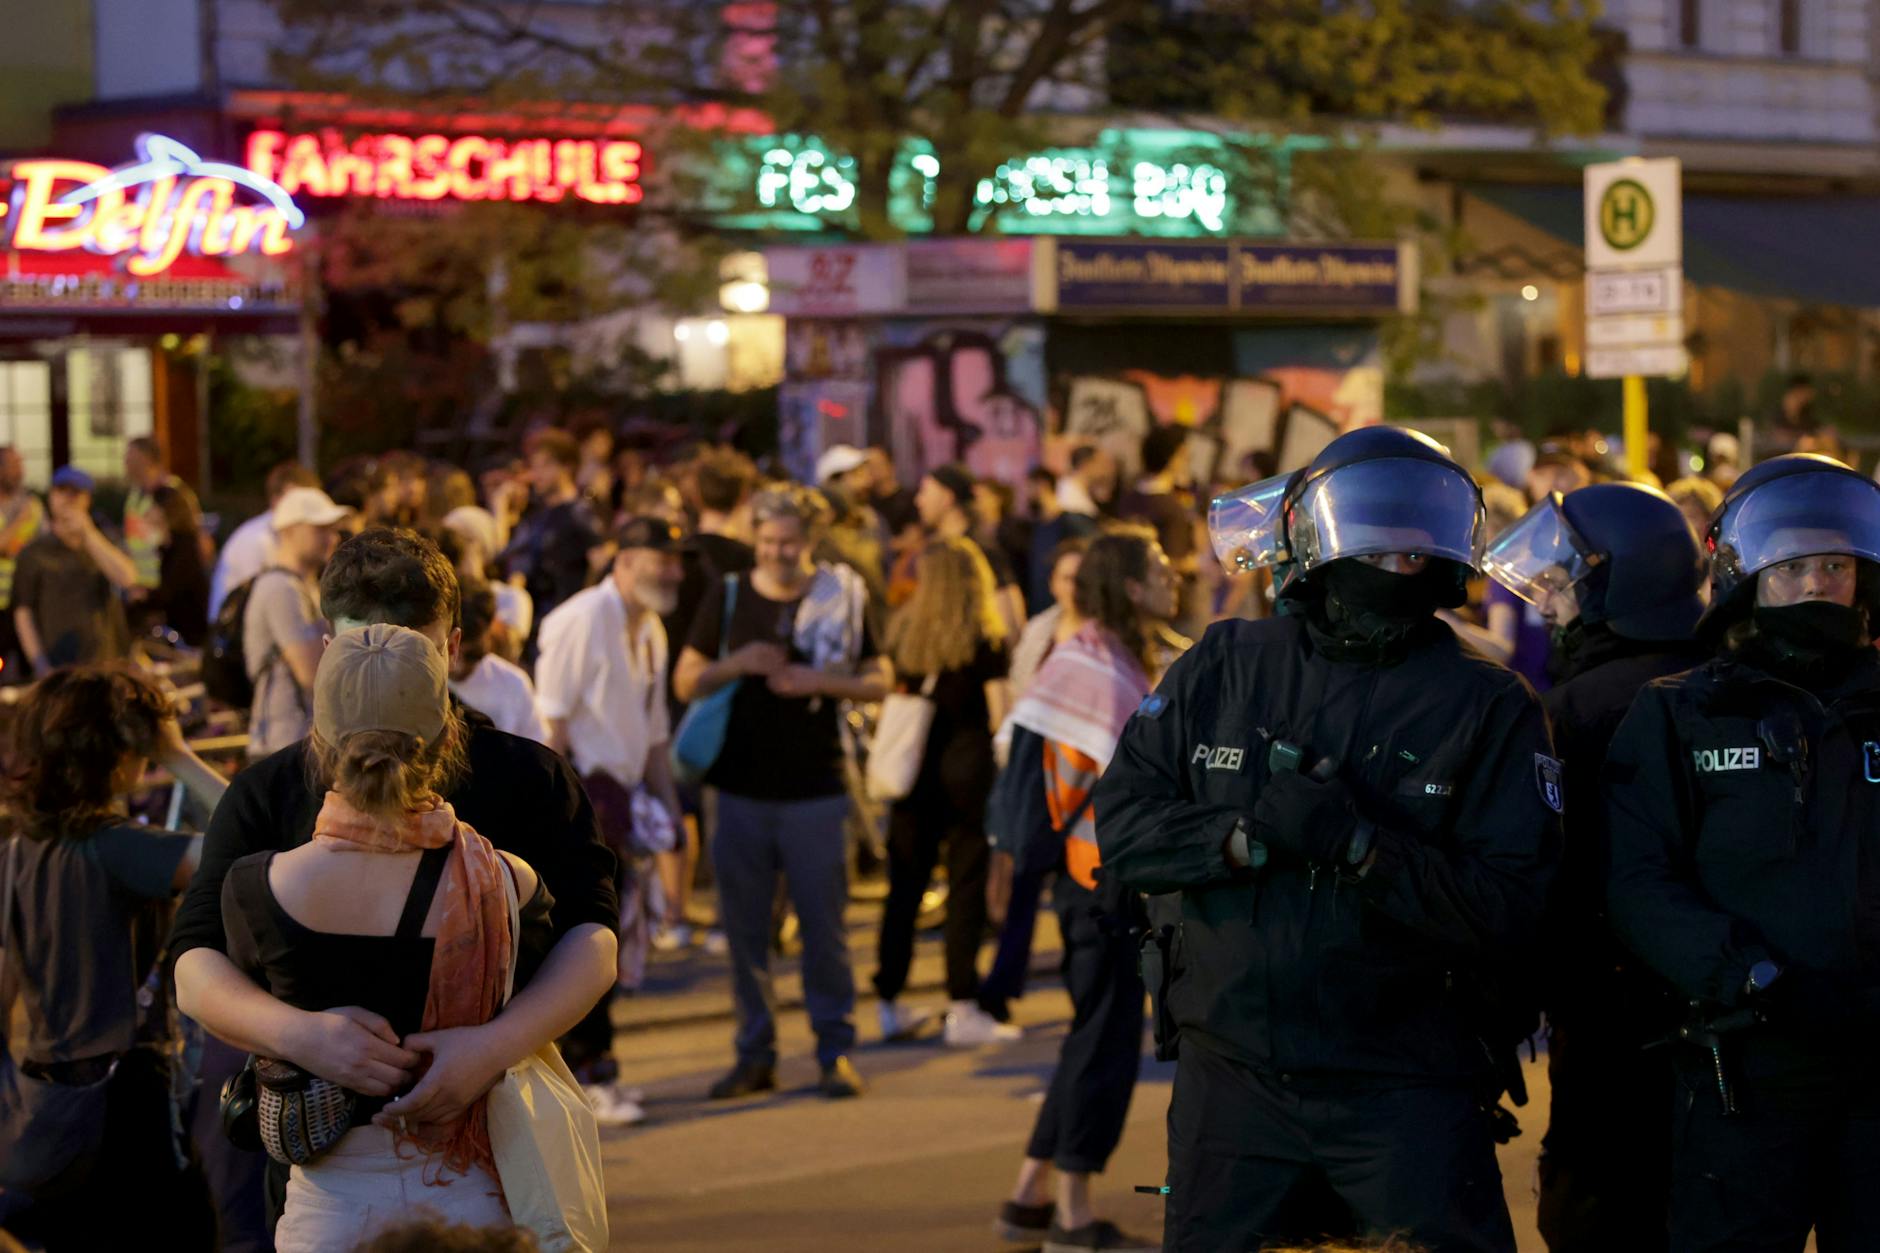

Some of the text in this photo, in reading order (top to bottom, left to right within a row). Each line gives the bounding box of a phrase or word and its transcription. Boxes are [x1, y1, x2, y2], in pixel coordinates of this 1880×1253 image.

[12, 160, 295, 276] Delfin
[1612, 196, 1638, 232] H
[1191, 743, 1244, 770] PLIZEI
[1693, 747, 1759, 772] POLIZEI
